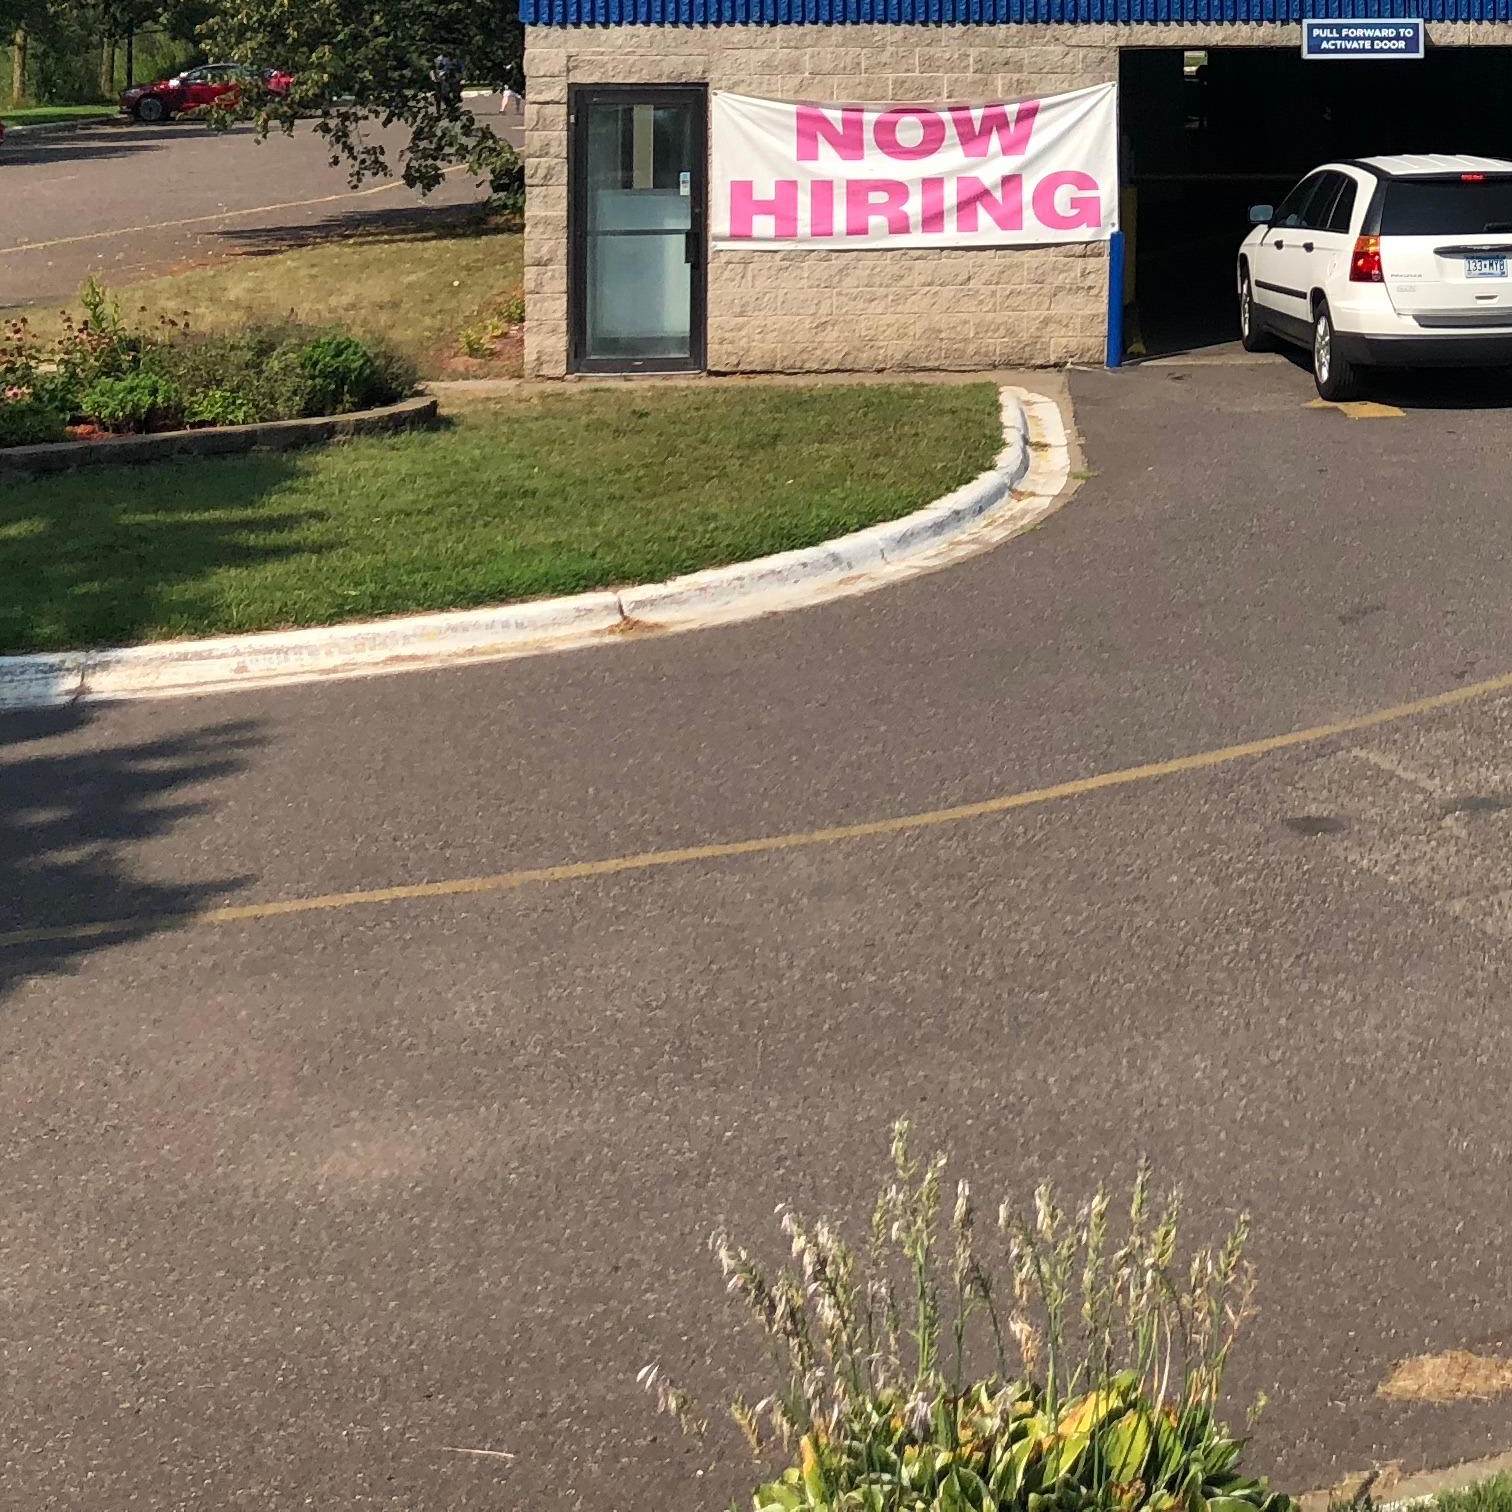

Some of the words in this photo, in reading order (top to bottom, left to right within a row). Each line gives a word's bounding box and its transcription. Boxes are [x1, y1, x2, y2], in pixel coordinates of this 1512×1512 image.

[1312, 28, 1339, 38] PULL
[1341, 28, 1397, 38] FORWARD
[1398, 28, 1414, 38] TO
[1320, 39, 1372, 50] ACTIVATE
[1373, 39, 1406, 50] DOOR
[795, 99, 1041, 162] NOW
[729, 170, 1102, 240] HIRING
